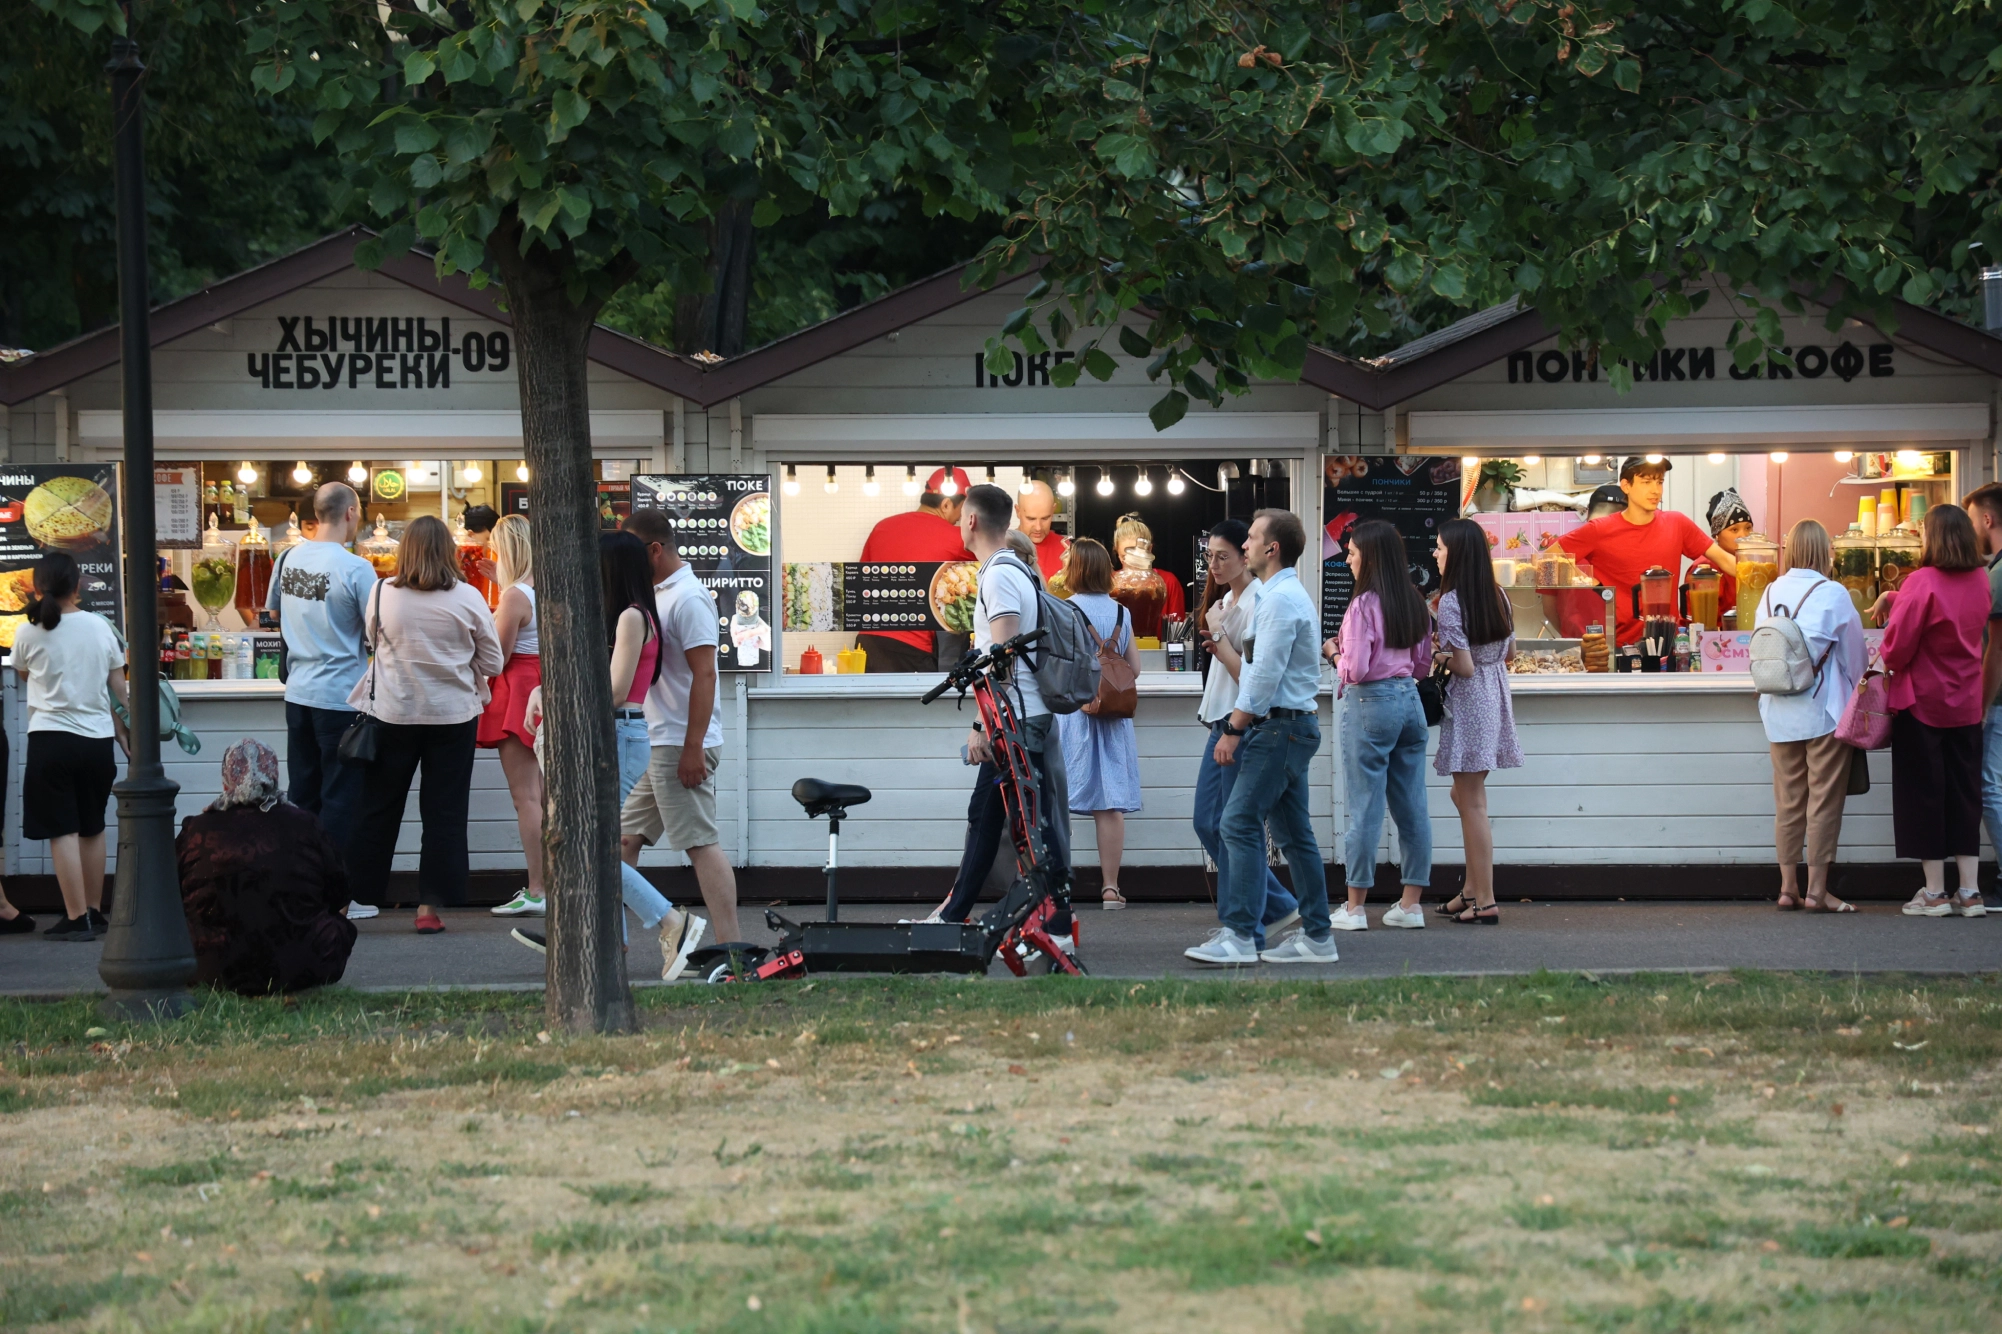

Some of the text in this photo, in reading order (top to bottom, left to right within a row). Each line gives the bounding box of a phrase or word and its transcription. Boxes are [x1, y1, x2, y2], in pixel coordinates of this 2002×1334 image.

[277, 316, 450, 352] ХЫЧИНЫ
[1508, 347, 1715, 383] ПОНИКИ
[1767, 341, 1896, 382] КОФЕ
[247, 353, 450, 389] ЧЕБУРЕКИ
[0, 475, 35, 486] ЧИНЫ
[727, 481, 763, 491] ПОКЕ
[77, 563, 113, 574] РЕКИ
[698, 577, 764, 588] ШИРИТТО
[1723, 648, 1750, 658] СМУ
